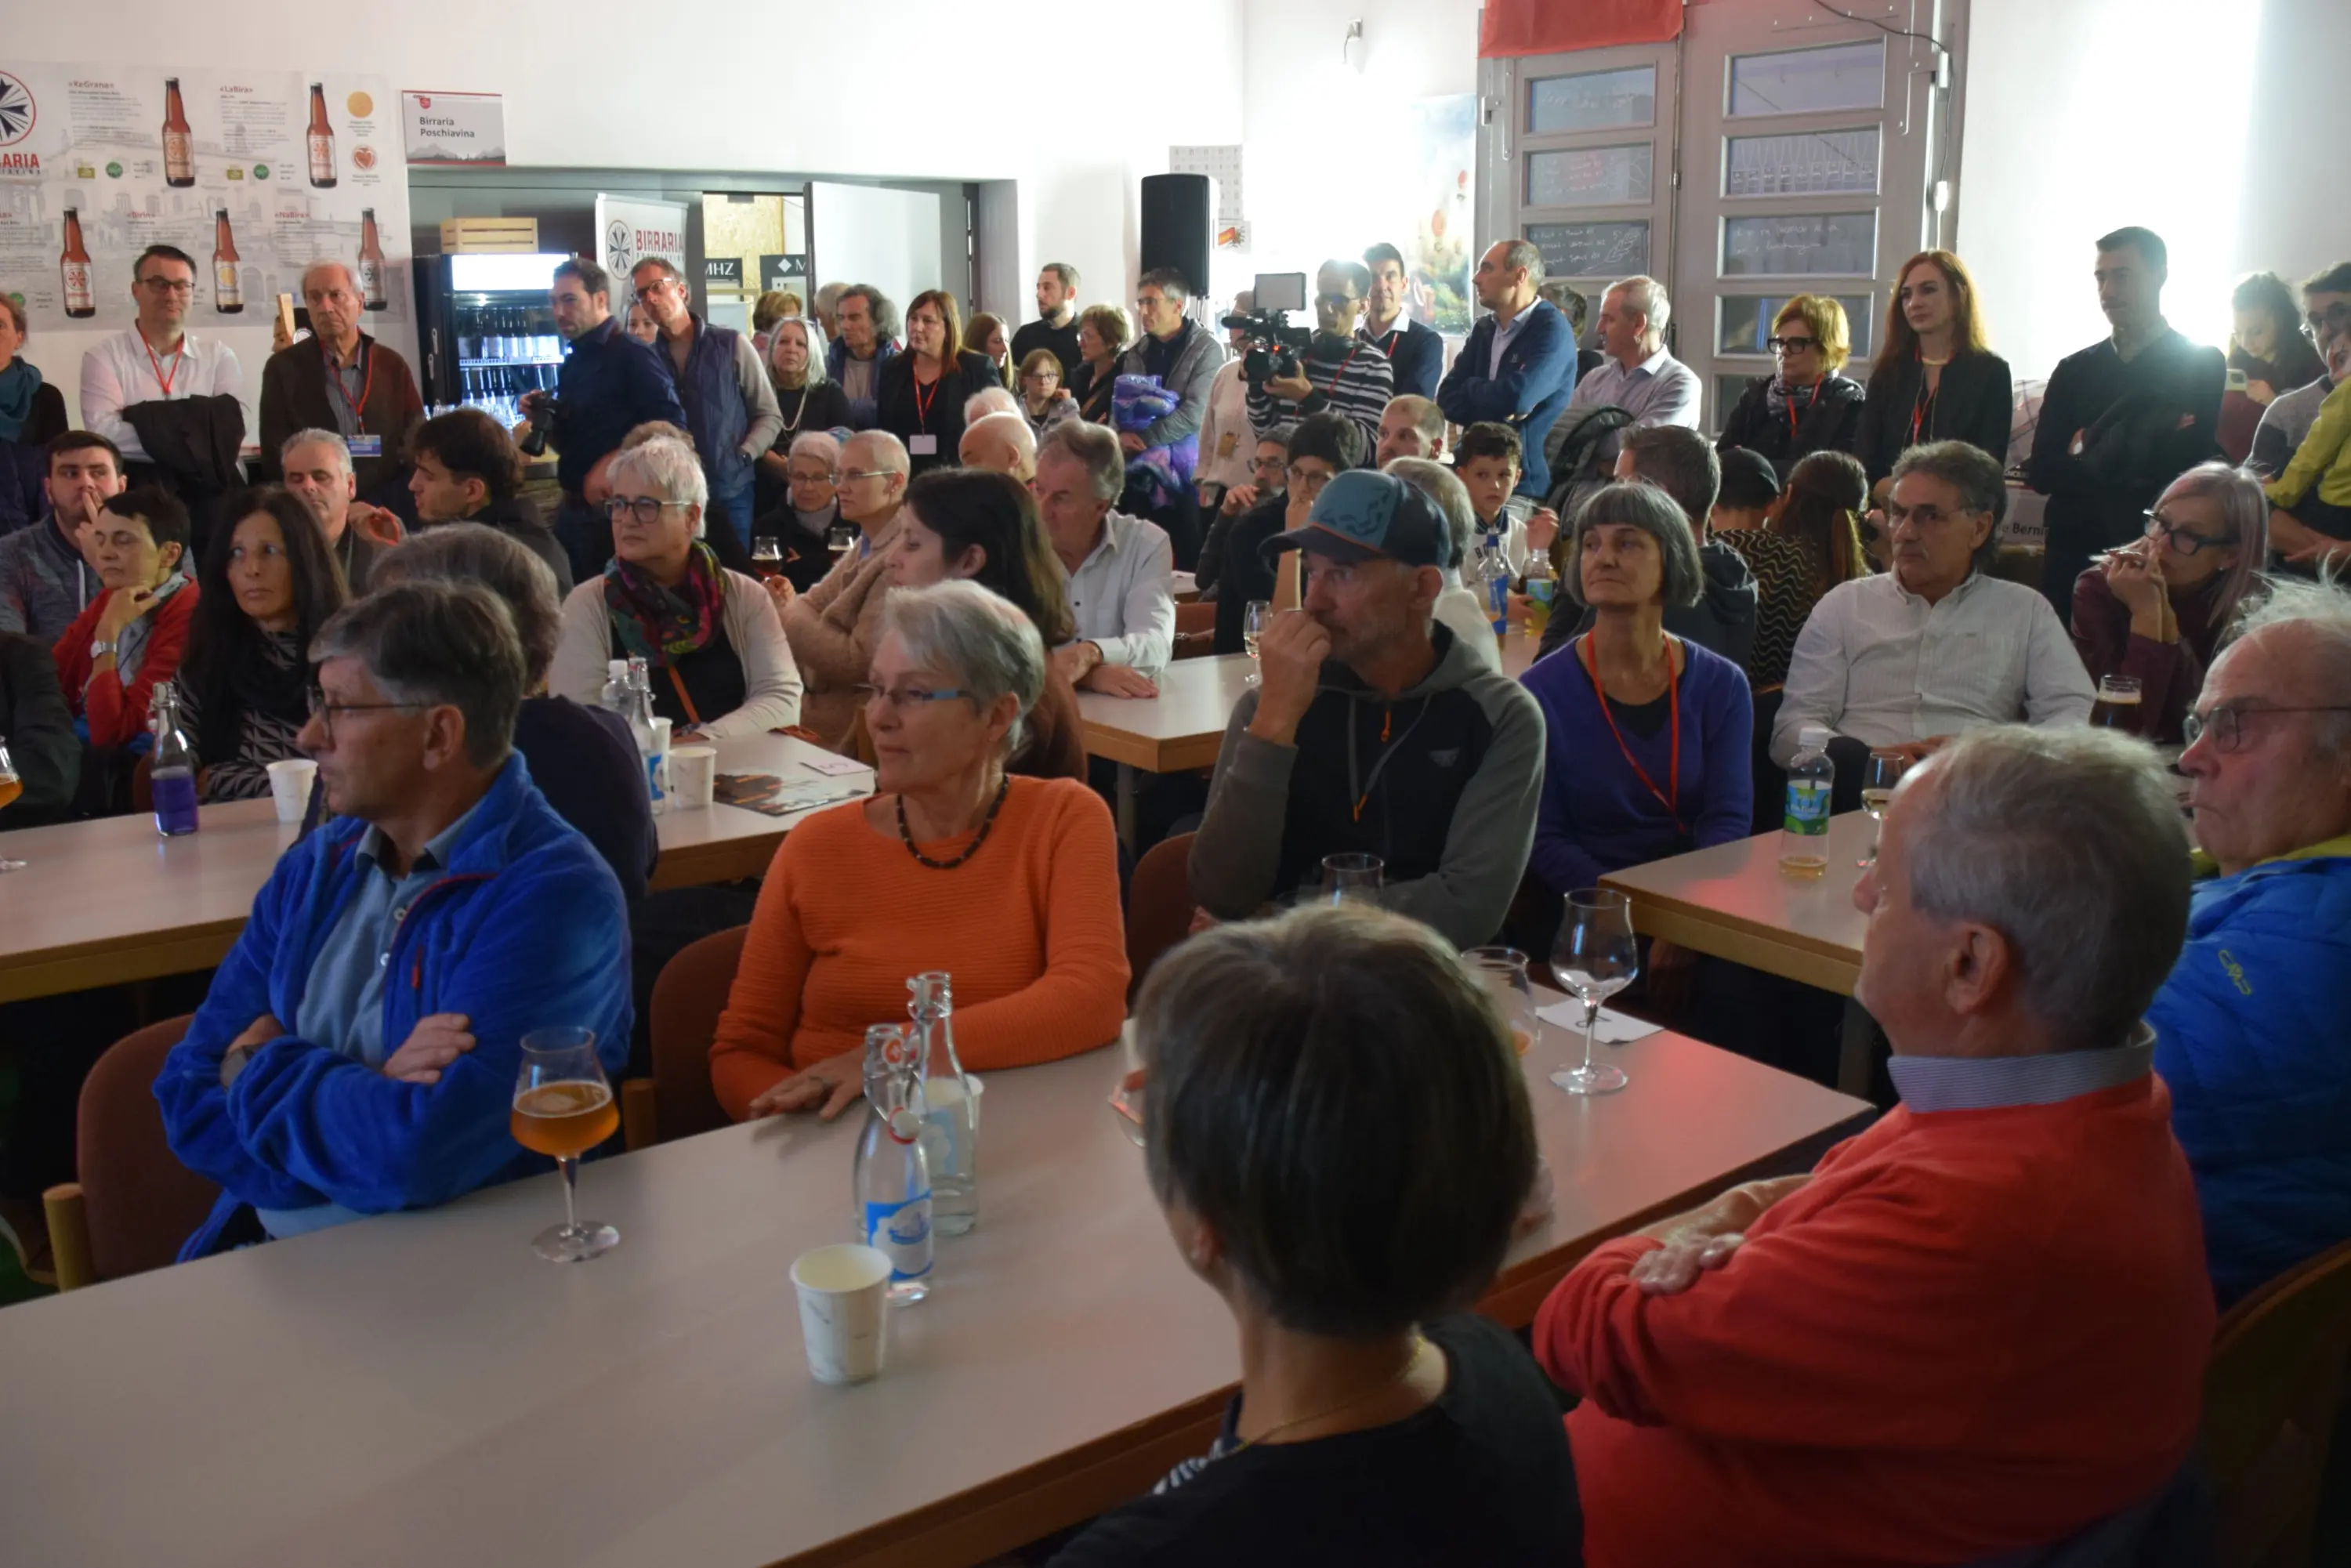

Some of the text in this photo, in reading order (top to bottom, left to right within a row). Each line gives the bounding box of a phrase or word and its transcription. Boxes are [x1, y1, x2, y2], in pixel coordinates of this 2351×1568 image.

[419, 117, 455, 125] Birraria
[420, 129, 475, 138] Poschiavina
[0, 153, 40, 168] ARIA
[636, 230, 684, 252] BIRRARIA
